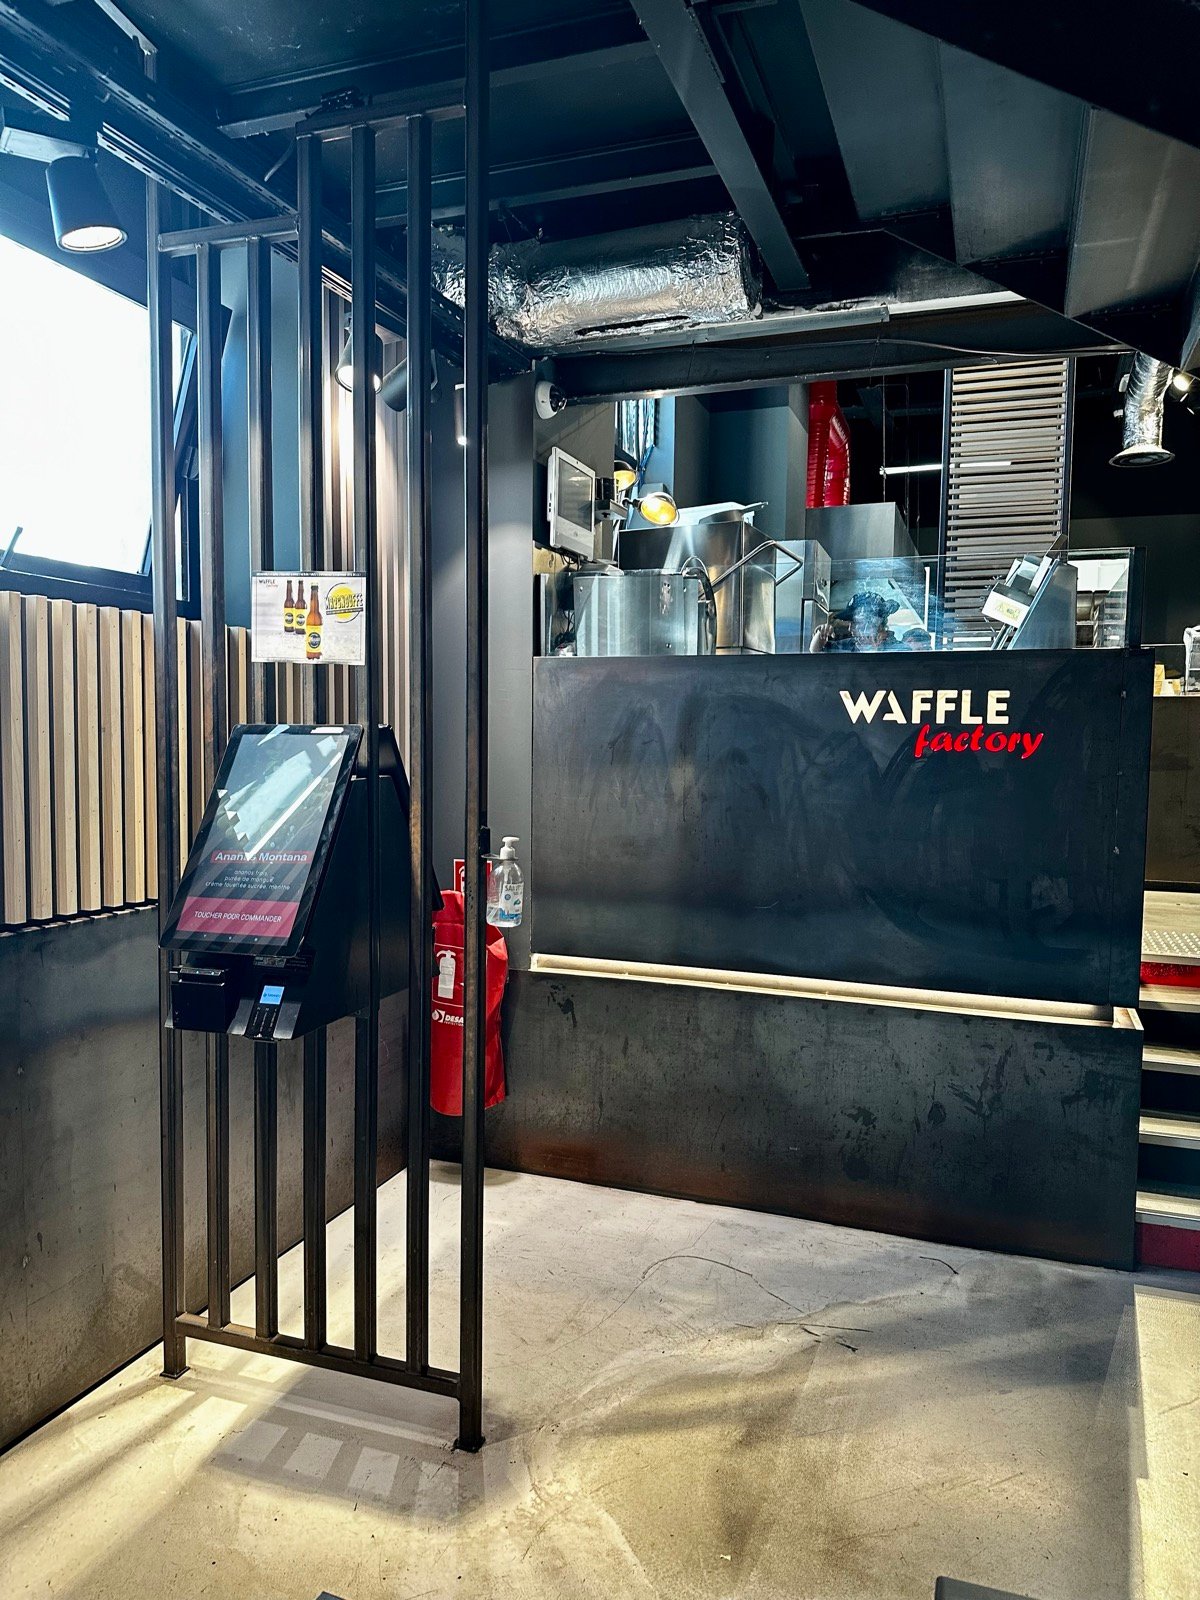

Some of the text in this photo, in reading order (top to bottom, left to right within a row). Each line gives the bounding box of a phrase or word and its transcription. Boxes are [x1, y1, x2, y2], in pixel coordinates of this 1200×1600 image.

[839, 689, 1011, 724] WAFFLE
[913, 723, 1044, 759] factory
[215, 852, 308, 862] Anans Montana
[194, 911, 282, 922] TOUCHER POUR COMMANDER
